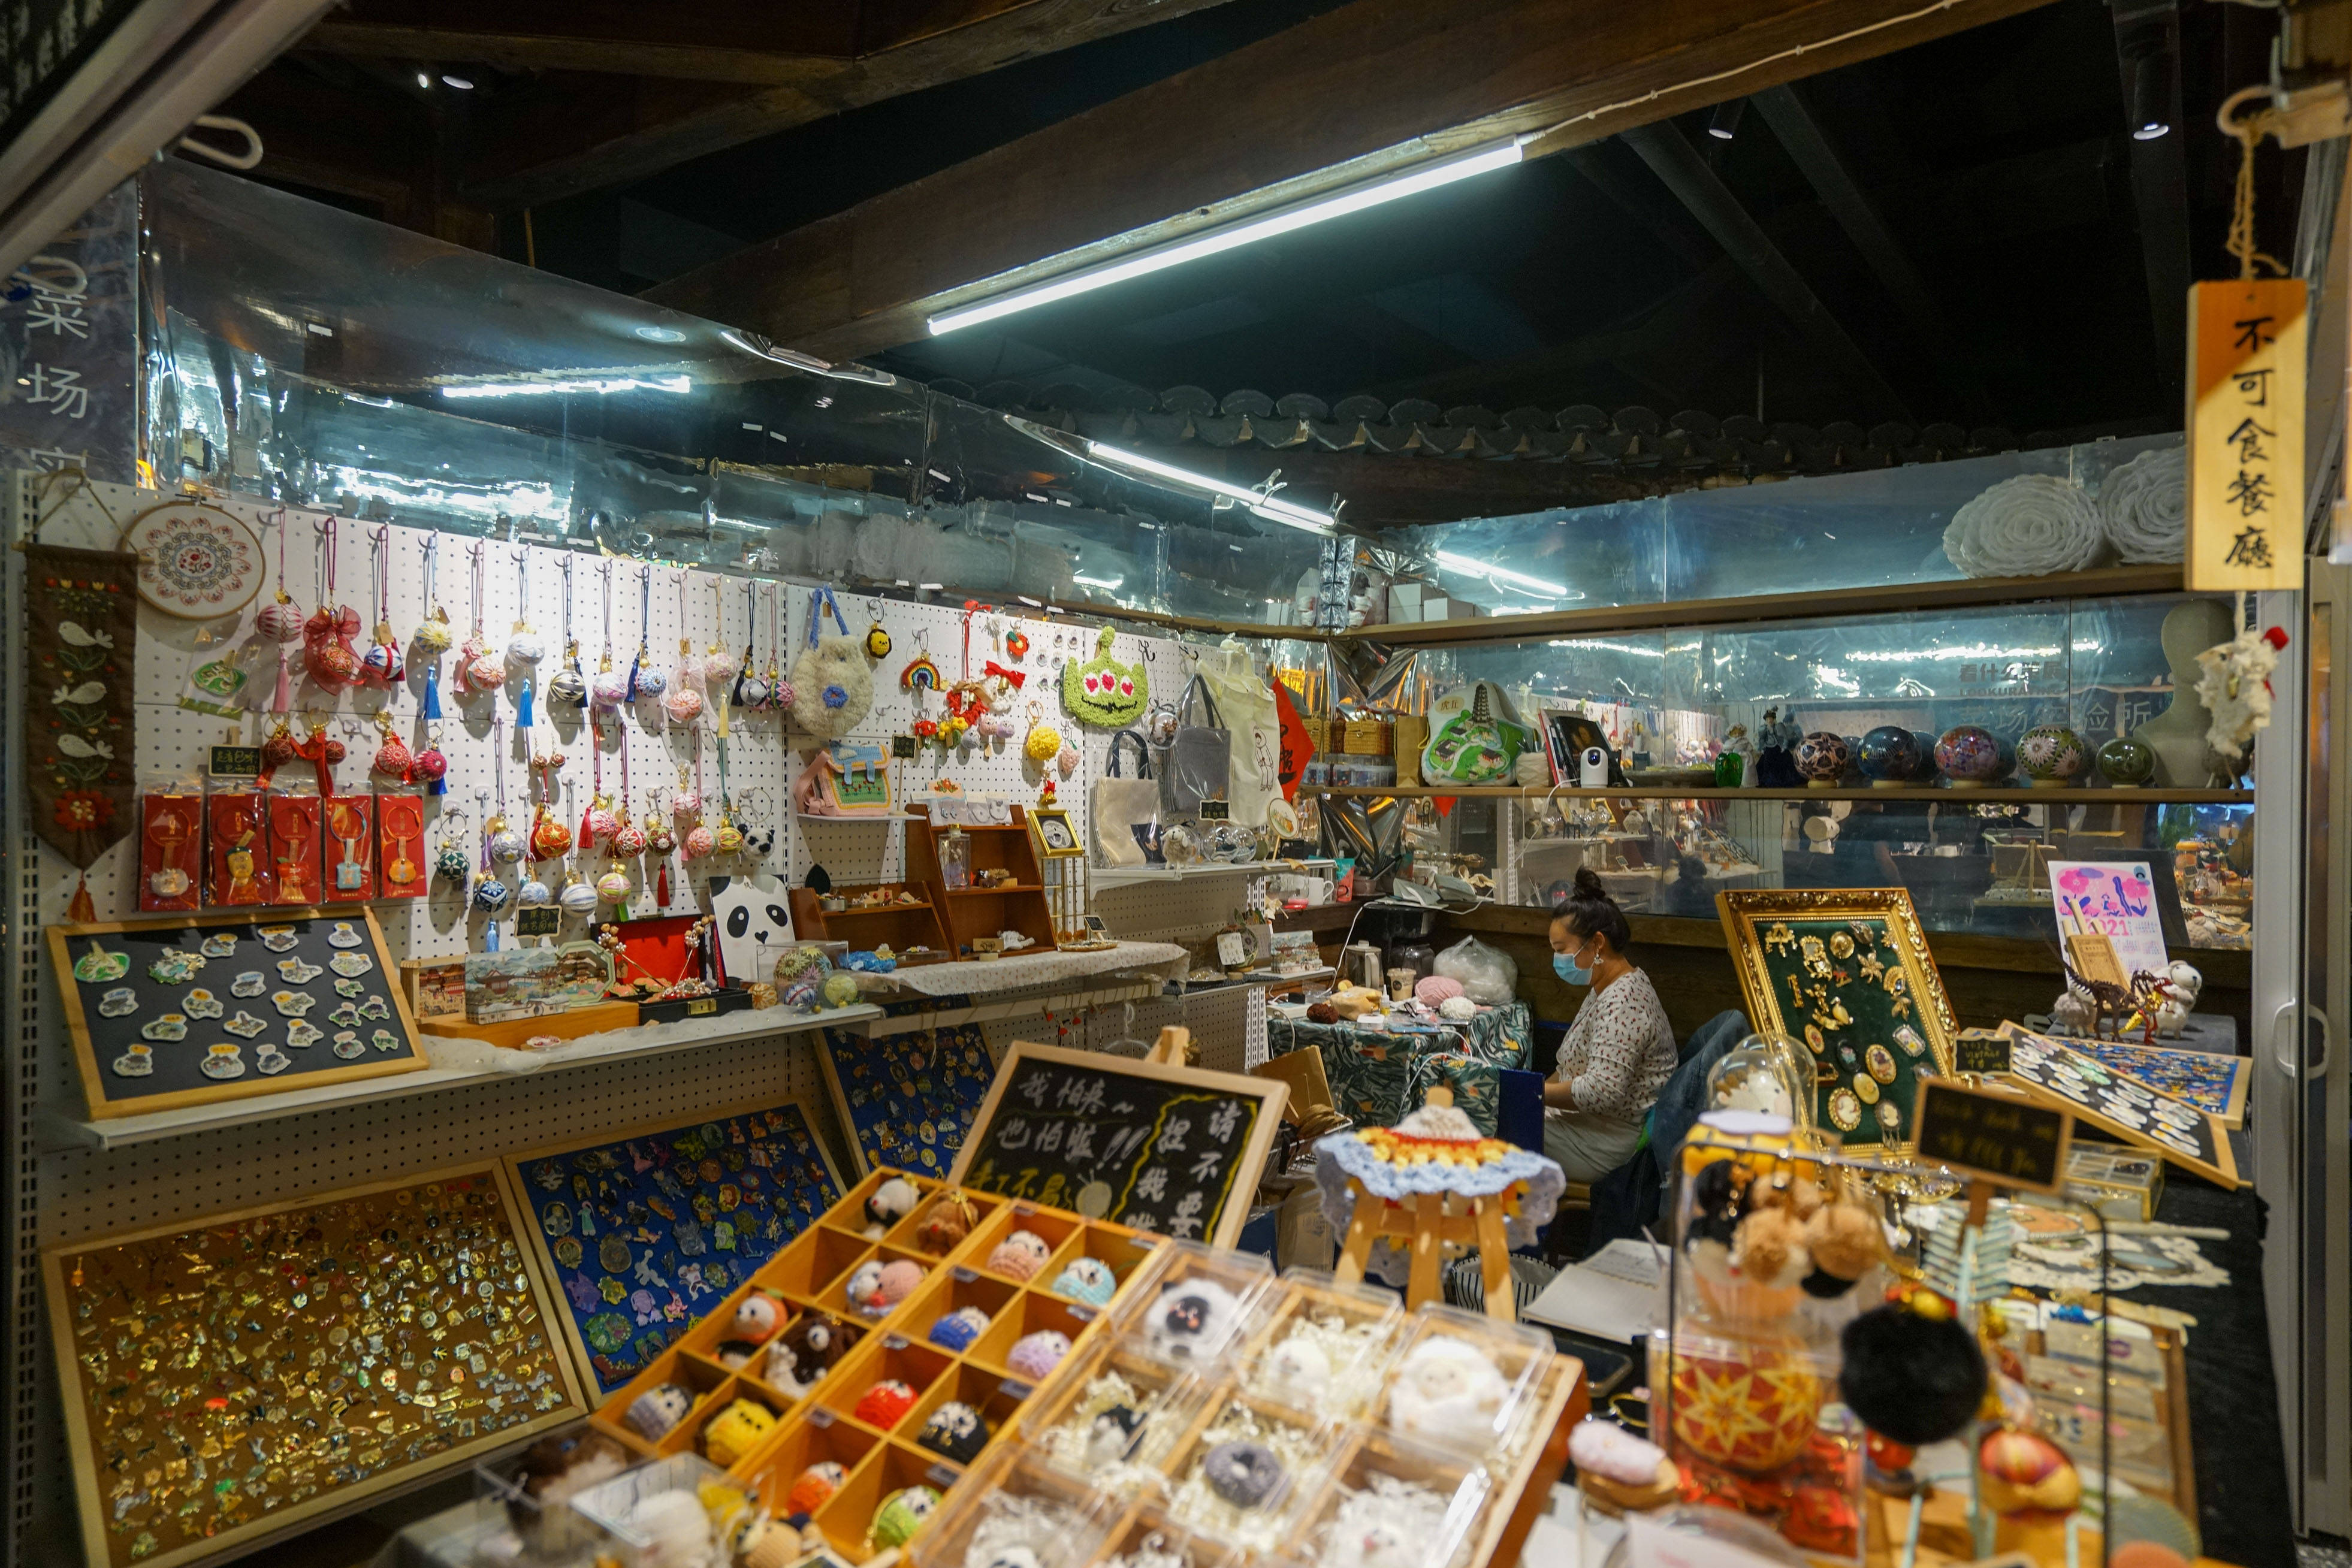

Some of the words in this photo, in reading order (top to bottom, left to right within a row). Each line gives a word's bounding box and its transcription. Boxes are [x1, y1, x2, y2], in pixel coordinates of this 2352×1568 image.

[2224, 316, 2277, 569] 不可食餐廳
